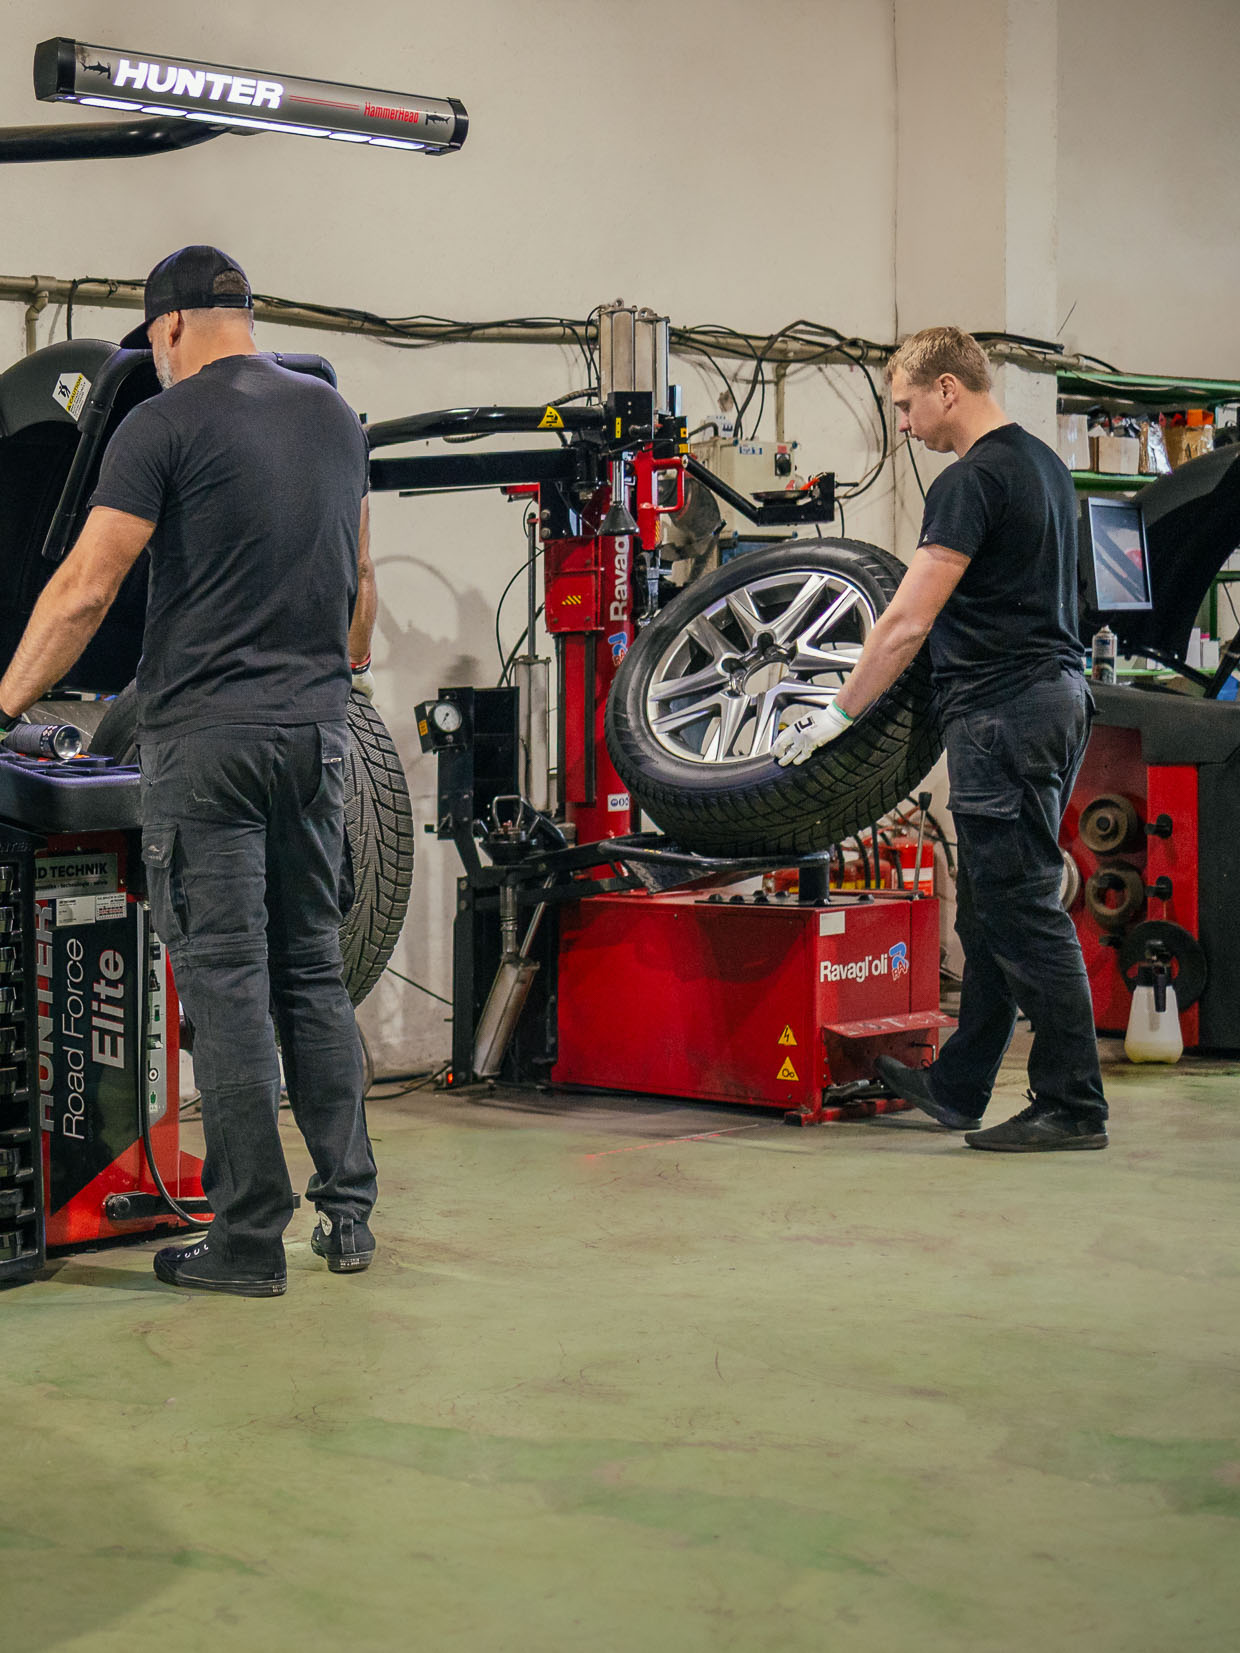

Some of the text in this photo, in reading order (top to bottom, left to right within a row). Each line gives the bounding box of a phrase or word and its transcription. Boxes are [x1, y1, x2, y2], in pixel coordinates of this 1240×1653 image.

[113, 59, 285, 109] HUNTER
[363, 101, 420, 124] HammerHead
[51, 862, 108, 879] TECHNIK
[62, 938, 84, 1039] Force
[91, 949, 125, 1070] Elite
[63, 1046, 85, 1140] Road
